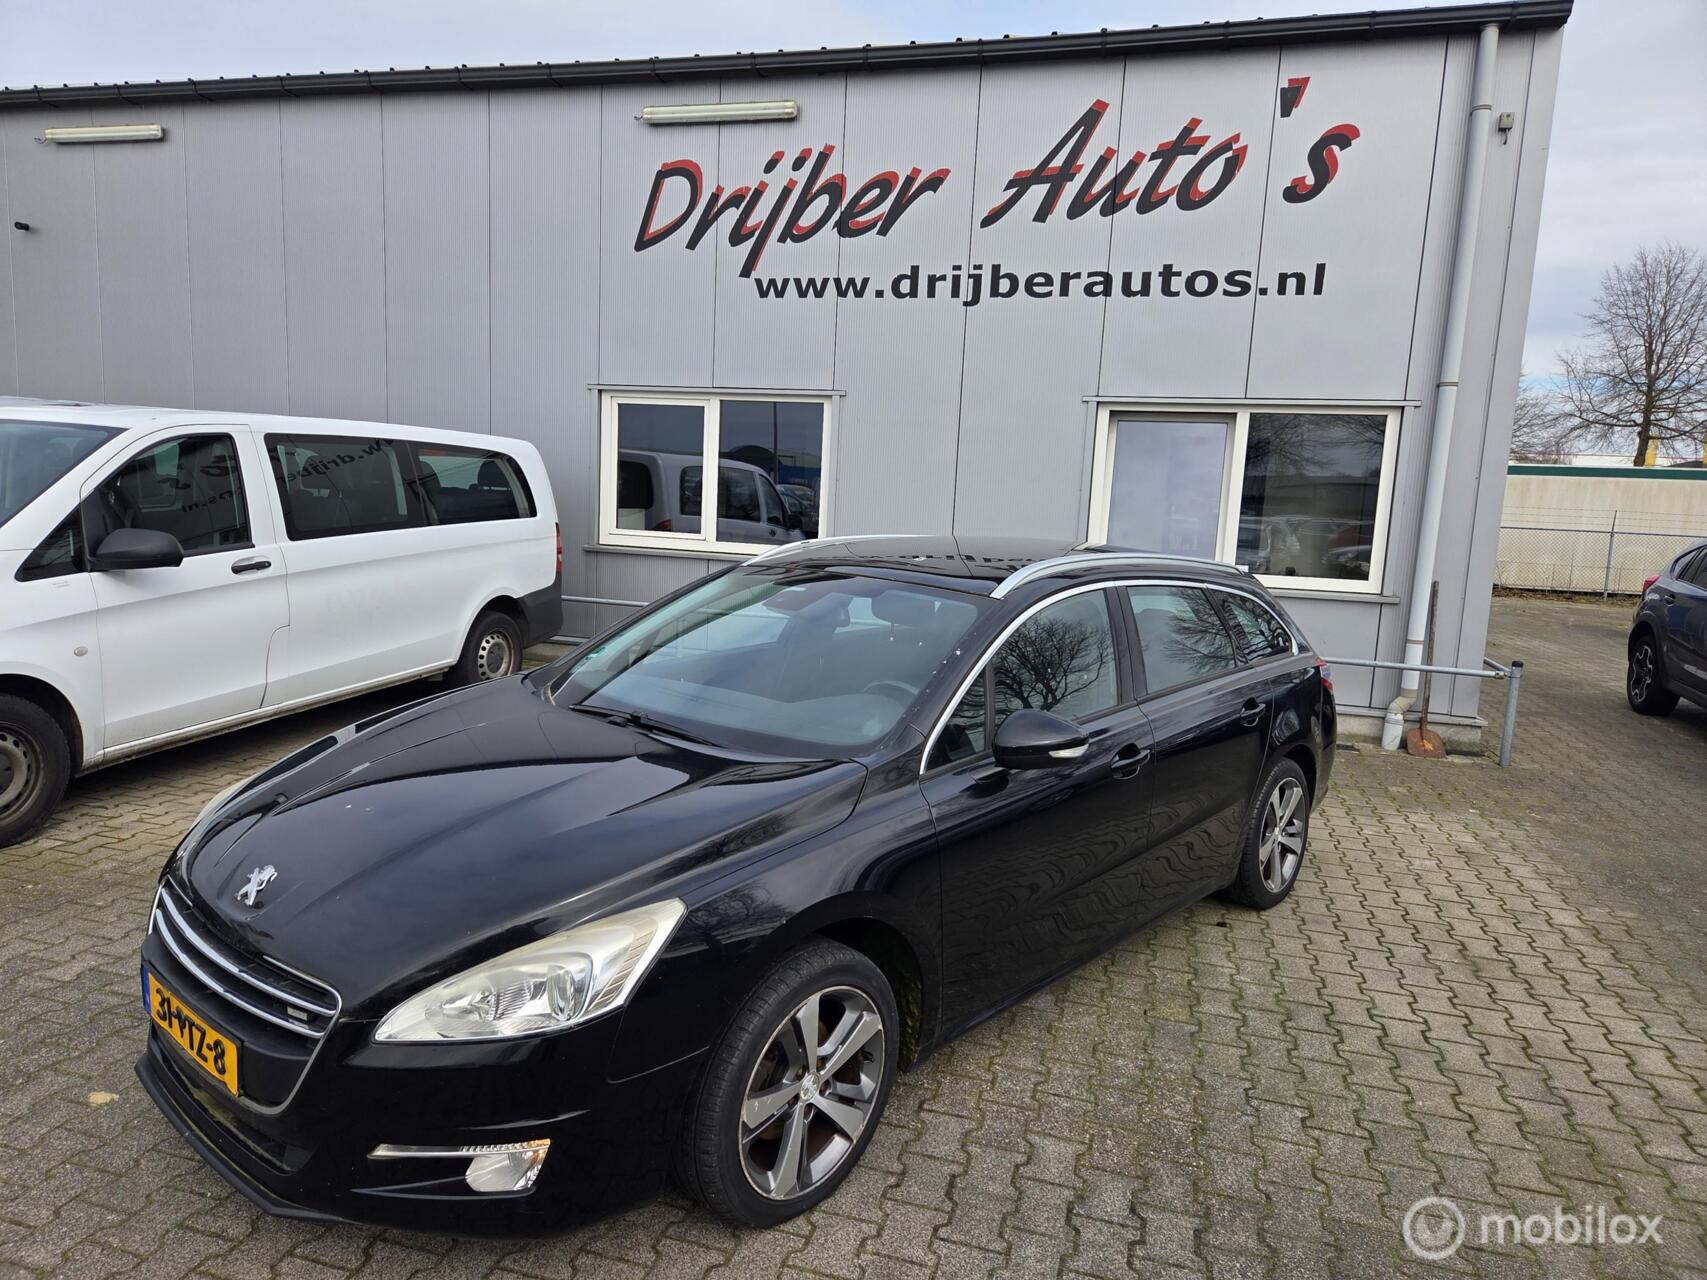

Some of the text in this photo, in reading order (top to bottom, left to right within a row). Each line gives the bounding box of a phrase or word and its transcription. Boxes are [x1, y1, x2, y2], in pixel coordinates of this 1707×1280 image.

[633, 76, 1361, 278] Drijber Auto's
[754, 262, 1326, 307] www.drijberautos.nl
